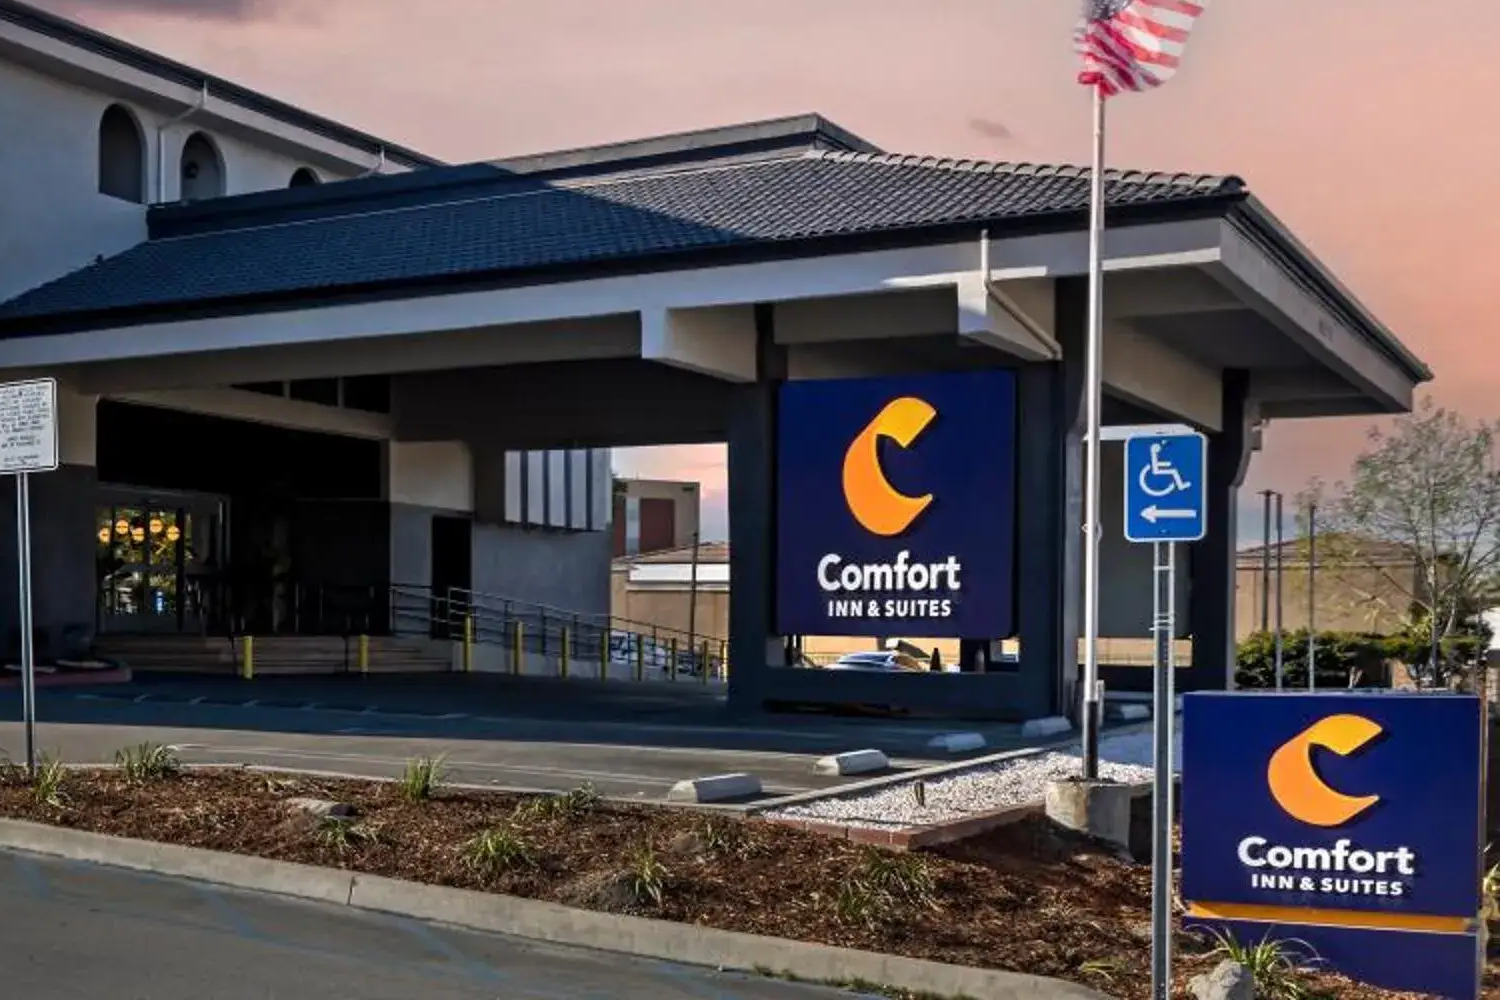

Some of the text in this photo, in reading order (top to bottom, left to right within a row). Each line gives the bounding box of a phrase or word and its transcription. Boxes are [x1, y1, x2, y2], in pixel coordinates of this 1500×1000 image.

[817, 549, 961, 593] Comfort
[827, 599, 952, 618] INN & SUITES
[1237, 835, 1415, 876] Comfort
[1251, 873, 1404, 897] INN & SUITES
